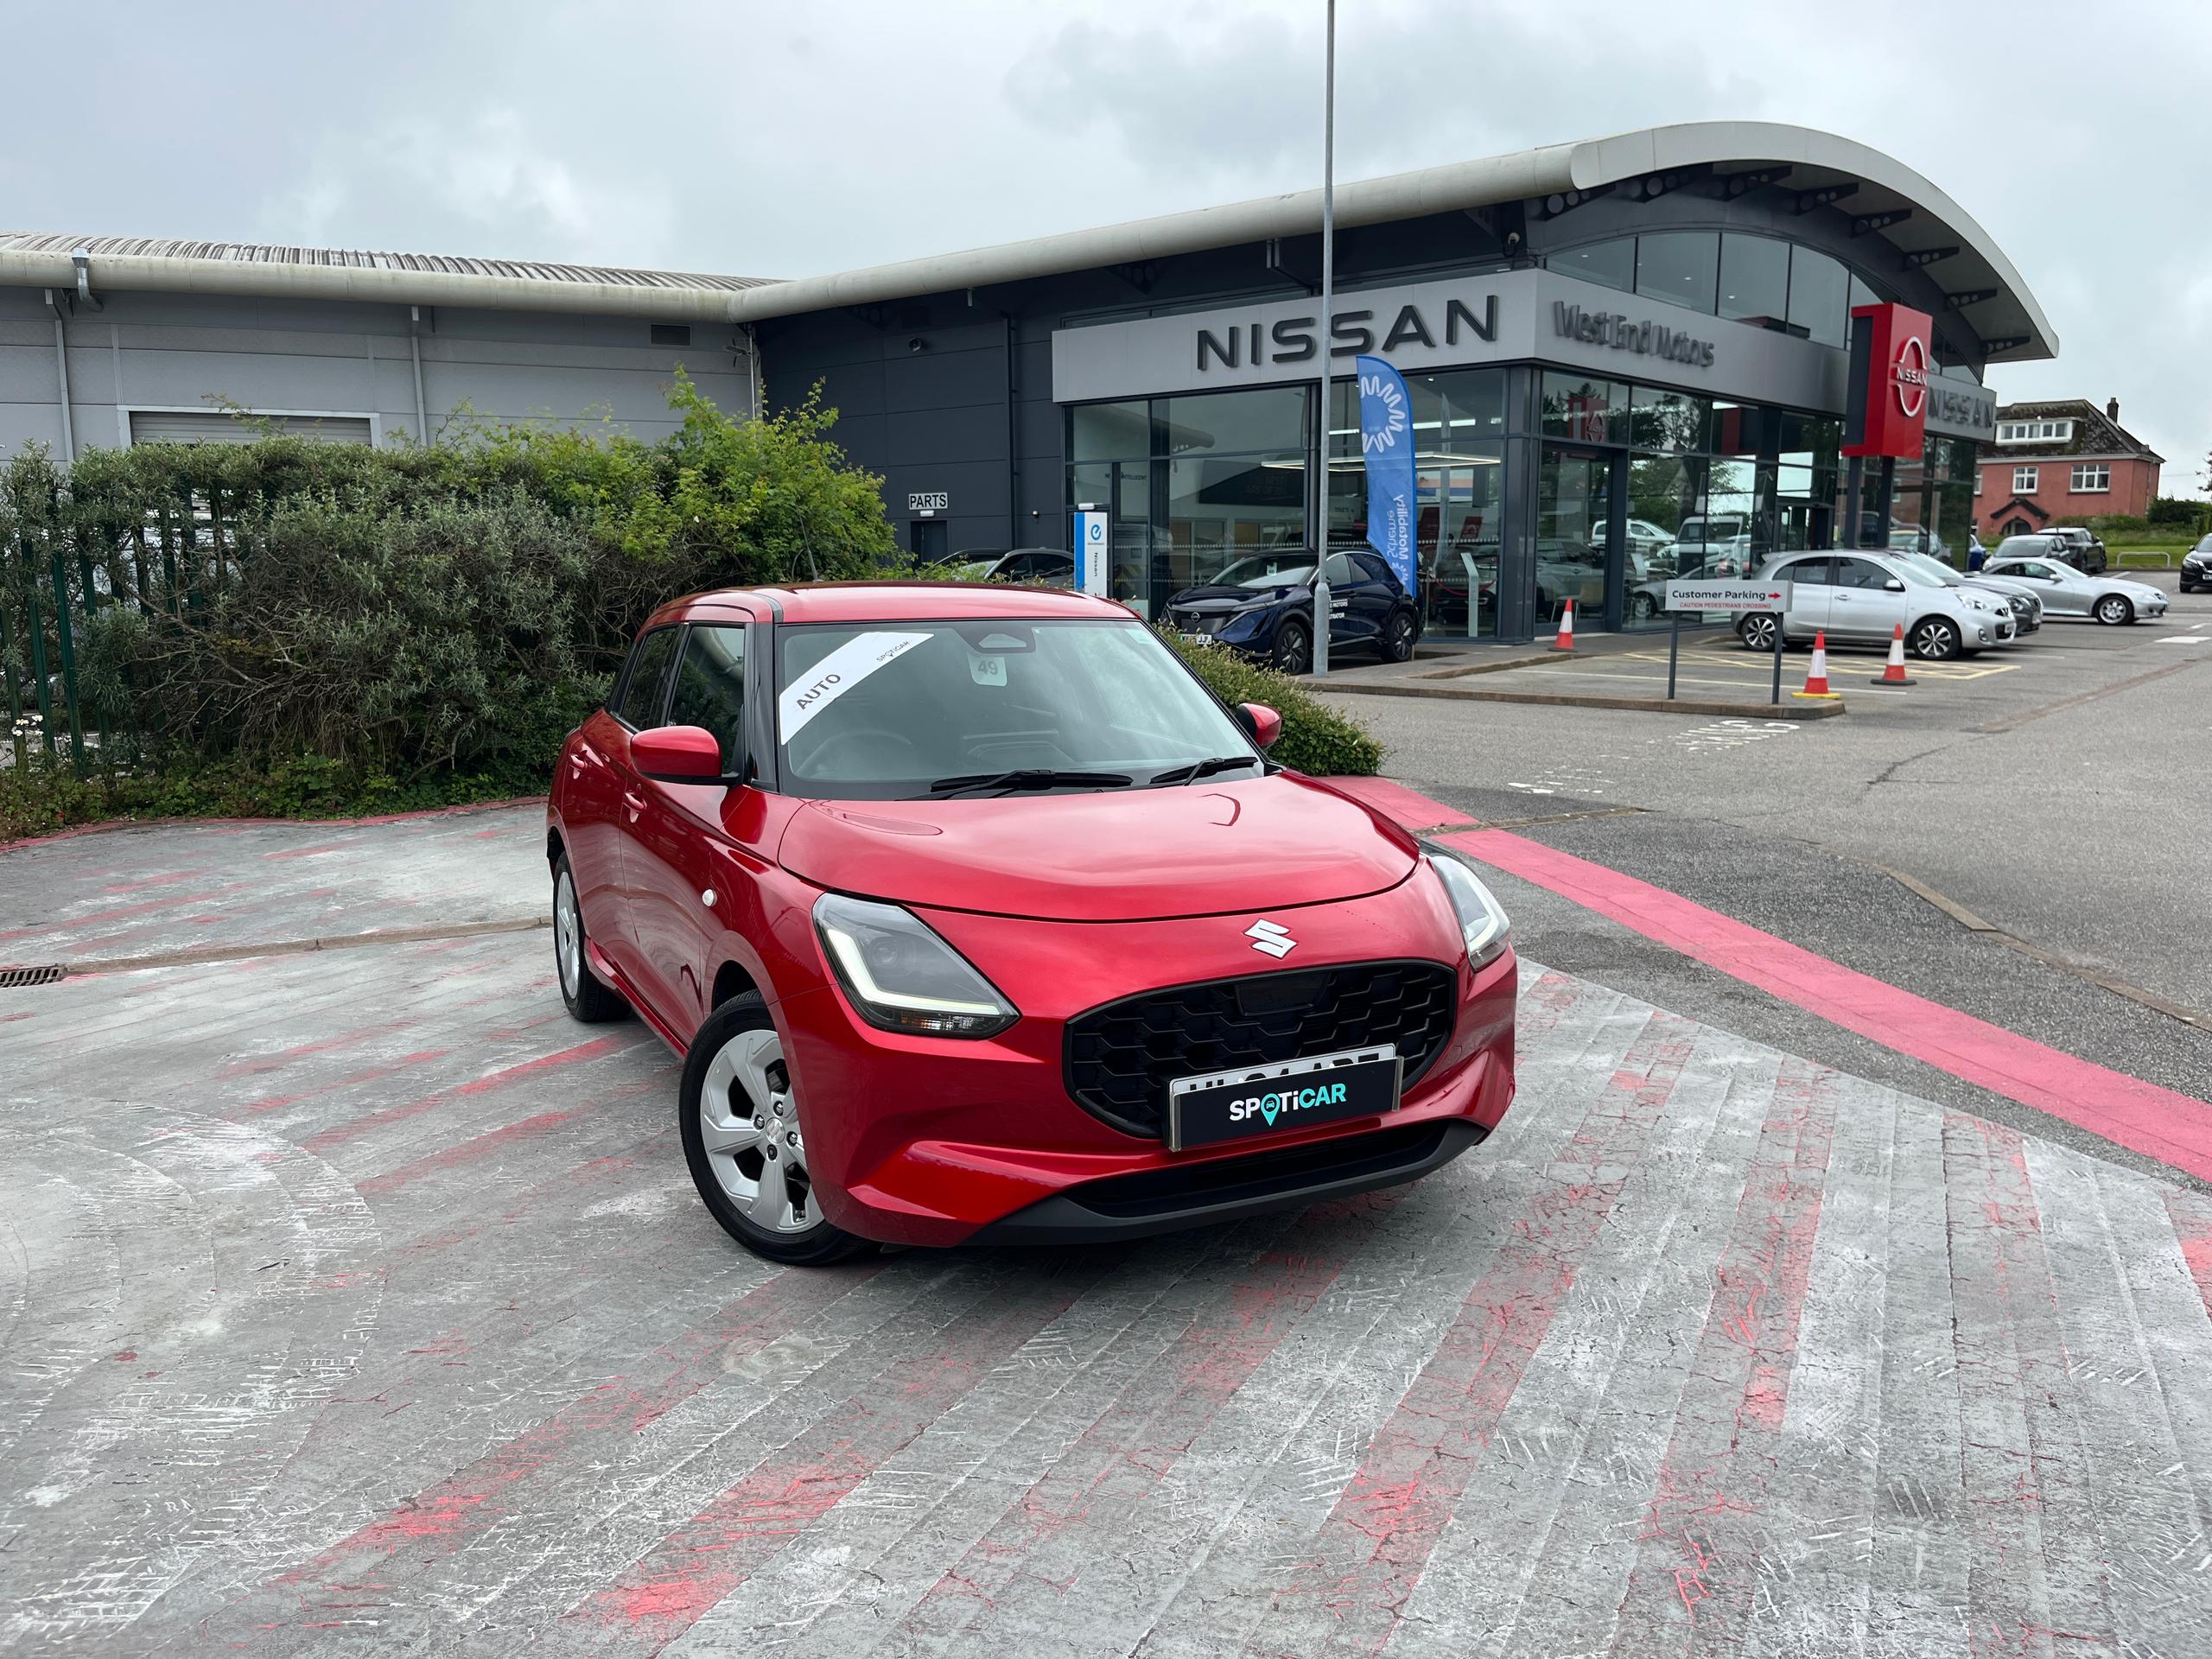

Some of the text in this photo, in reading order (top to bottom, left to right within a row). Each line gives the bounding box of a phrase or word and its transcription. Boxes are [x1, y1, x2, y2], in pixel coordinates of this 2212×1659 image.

[1197, 295, 1498, 371] NISSAN
[1554, 301, 1610, 345] West
[1610, 315, 1651, 353] End
[1896, 366, 1929, 386] NISSAN
[1928, 387, 1994, 429] NISSAN
[910, 494, 946, 508] PARTS
[1672, 590, 1766, 601] Customer Parking
[977, 659, 999, 676] 49
[796, 674, 841, 710] AUTO
